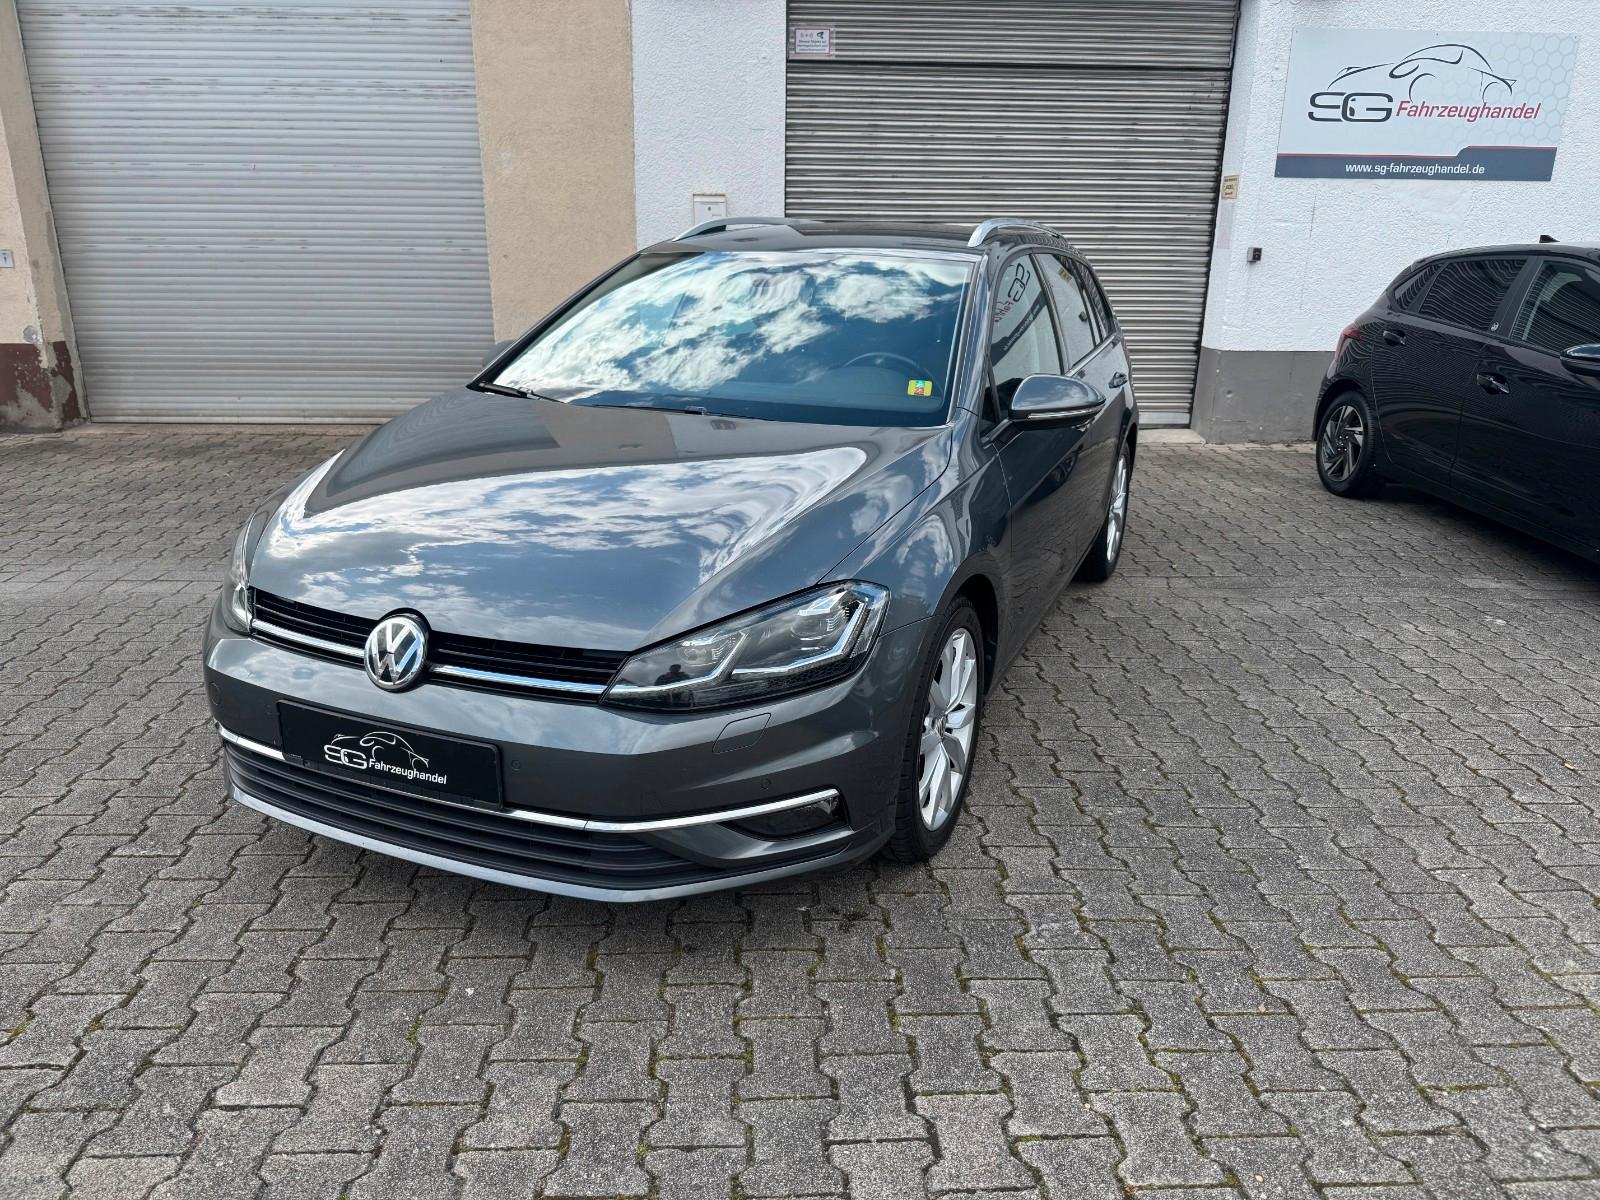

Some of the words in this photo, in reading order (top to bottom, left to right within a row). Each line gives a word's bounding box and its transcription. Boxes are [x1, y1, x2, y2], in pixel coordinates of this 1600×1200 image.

[1307, 91, 1394, 123] SG
[1395, 100, 1542, 123] Fahrzeughandel
[1345, 162, 1486, 176] www.sg-fahrzeughandel.de
[323, 744, 368, 770] SG
[368, 758, 447, 785] Fahrzeughandel
